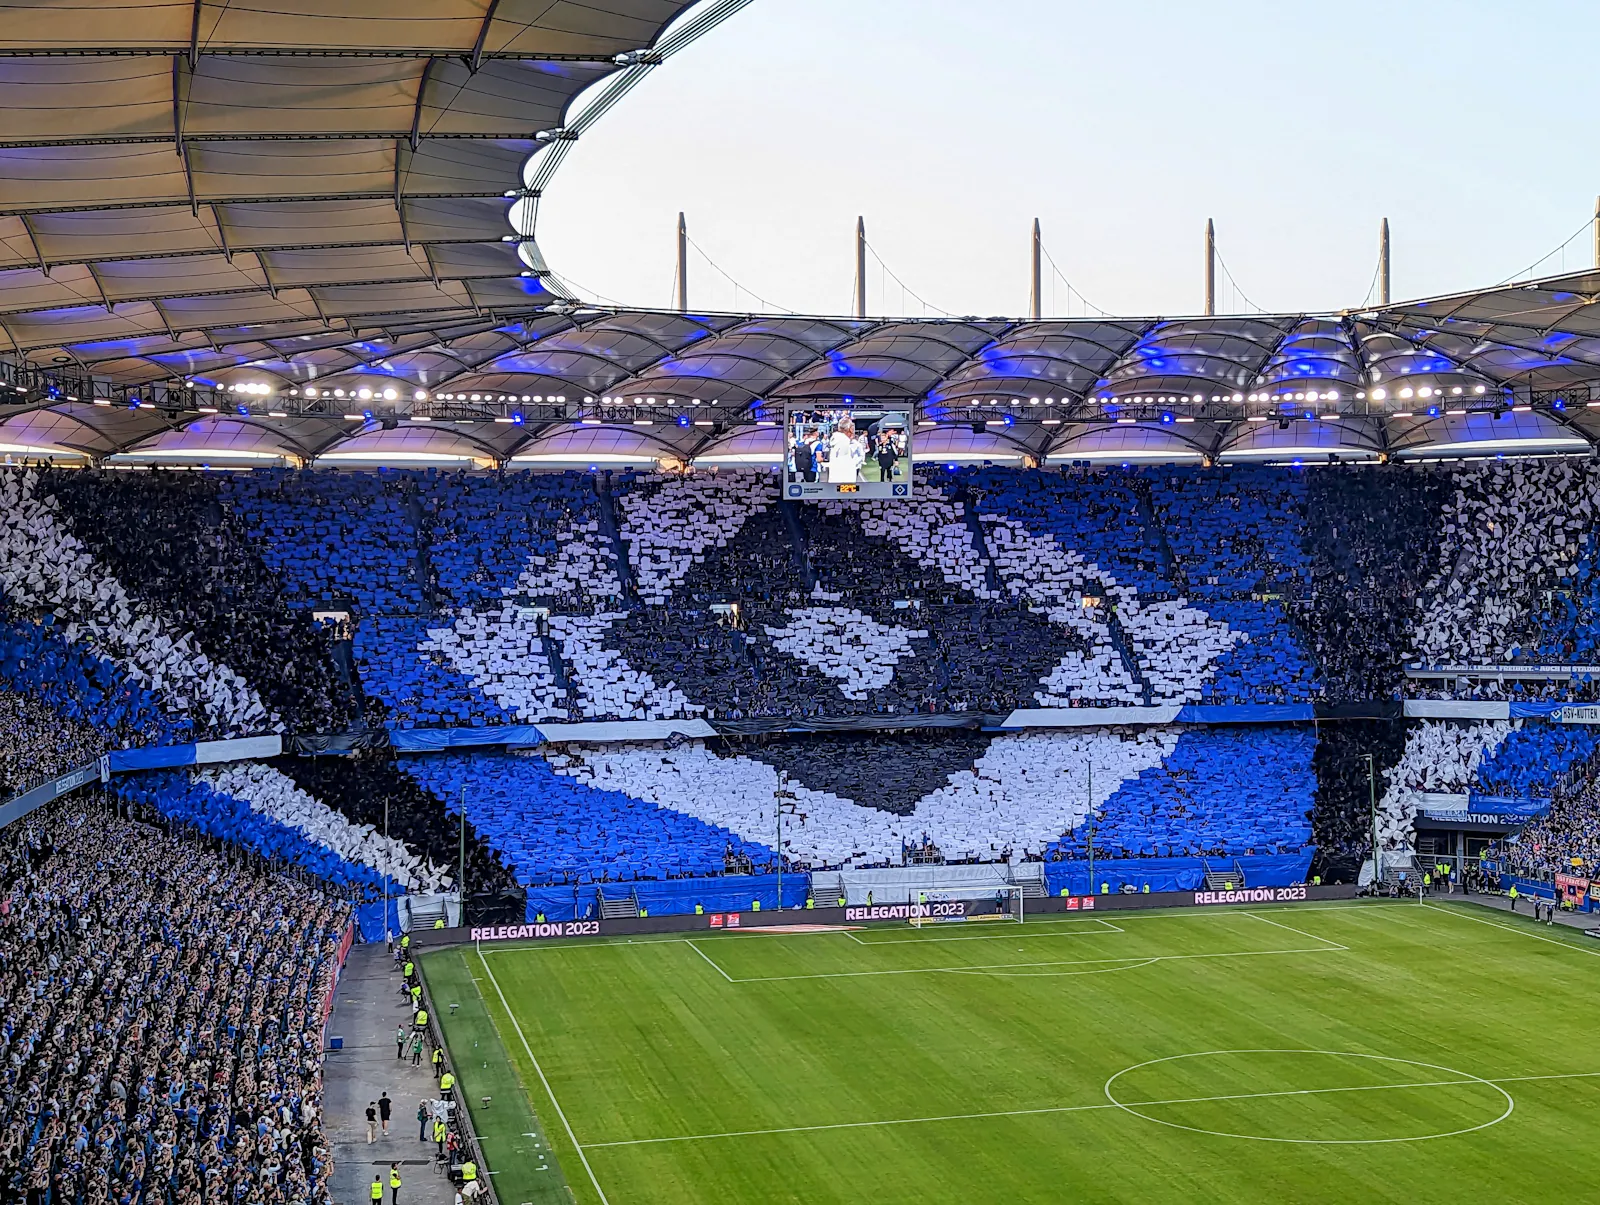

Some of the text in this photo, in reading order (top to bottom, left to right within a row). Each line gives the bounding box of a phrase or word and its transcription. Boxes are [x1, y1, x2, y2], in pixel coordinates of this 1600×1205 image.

[1194, 887, 1306, 904] RELEGATION 2023
[845, 902, 965, 920] RELEGATION 2023
[470, 921, 600, 940] RELEGATION 2023
